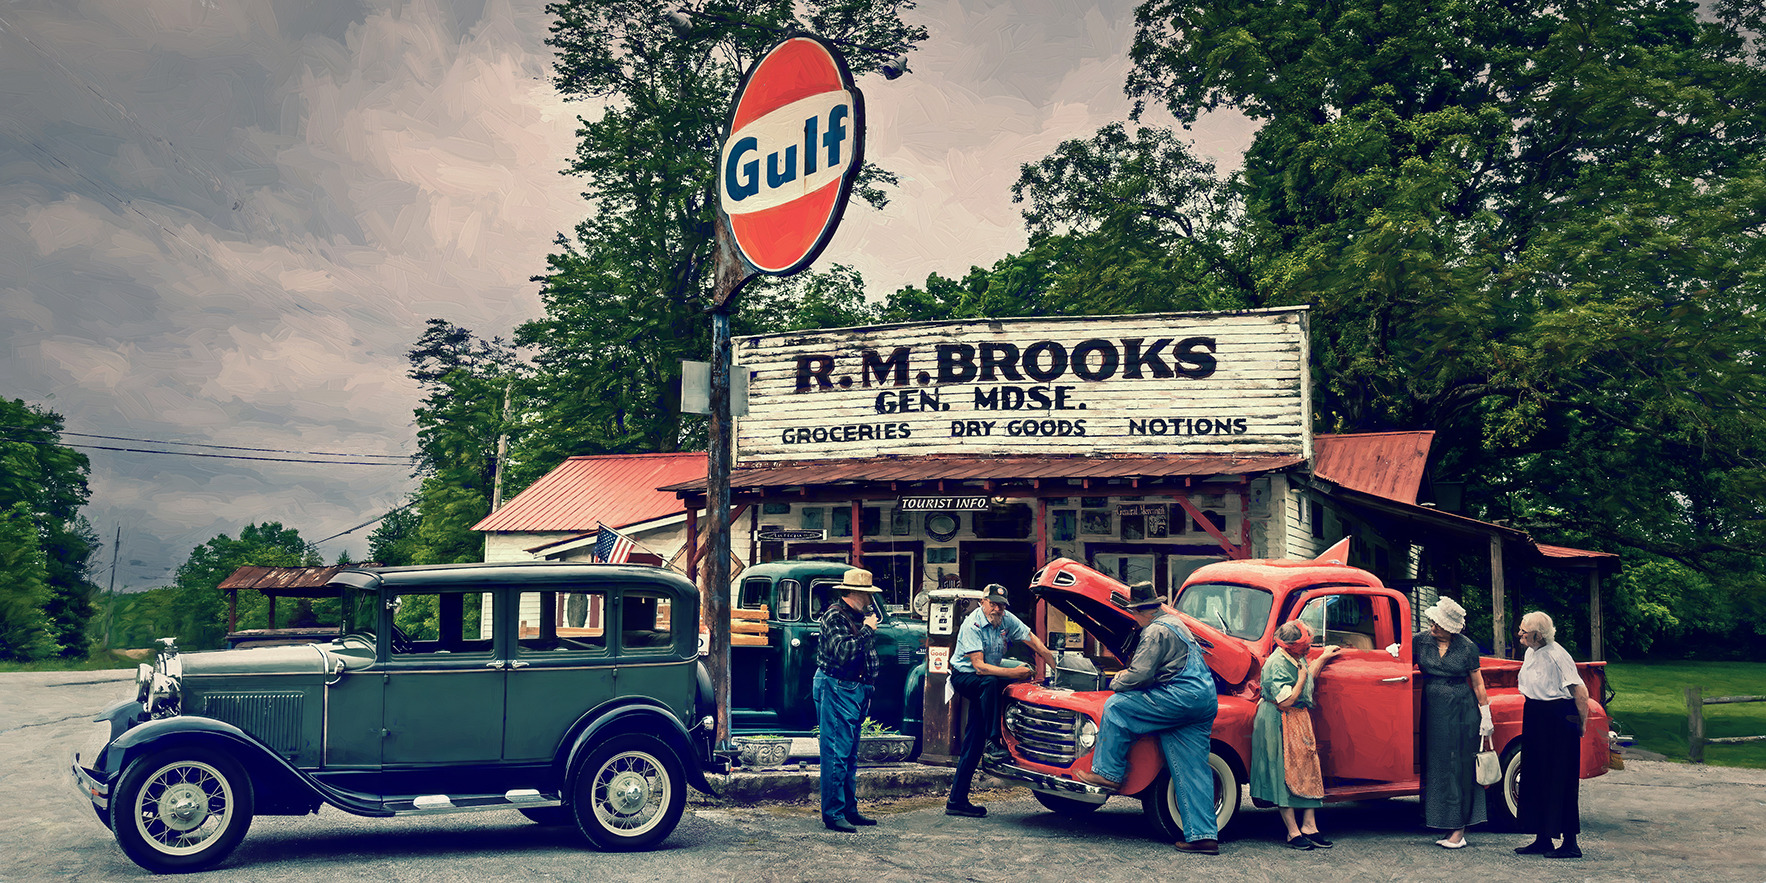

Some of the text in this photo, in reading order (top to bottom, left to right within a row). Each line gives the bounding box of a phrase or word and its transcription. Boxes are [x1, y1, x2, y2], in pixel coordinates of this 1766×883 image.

[725, 103, 848, 201] Gulf
[875, 385, 1087, 414] GEN. MDSE.
[781, 417, 1249, 445] GROCERIES DRY GOODS NOTIONS
[902, 498, 989, 509] TOURIST INFO.
[930, 649, 947, 657] Good
